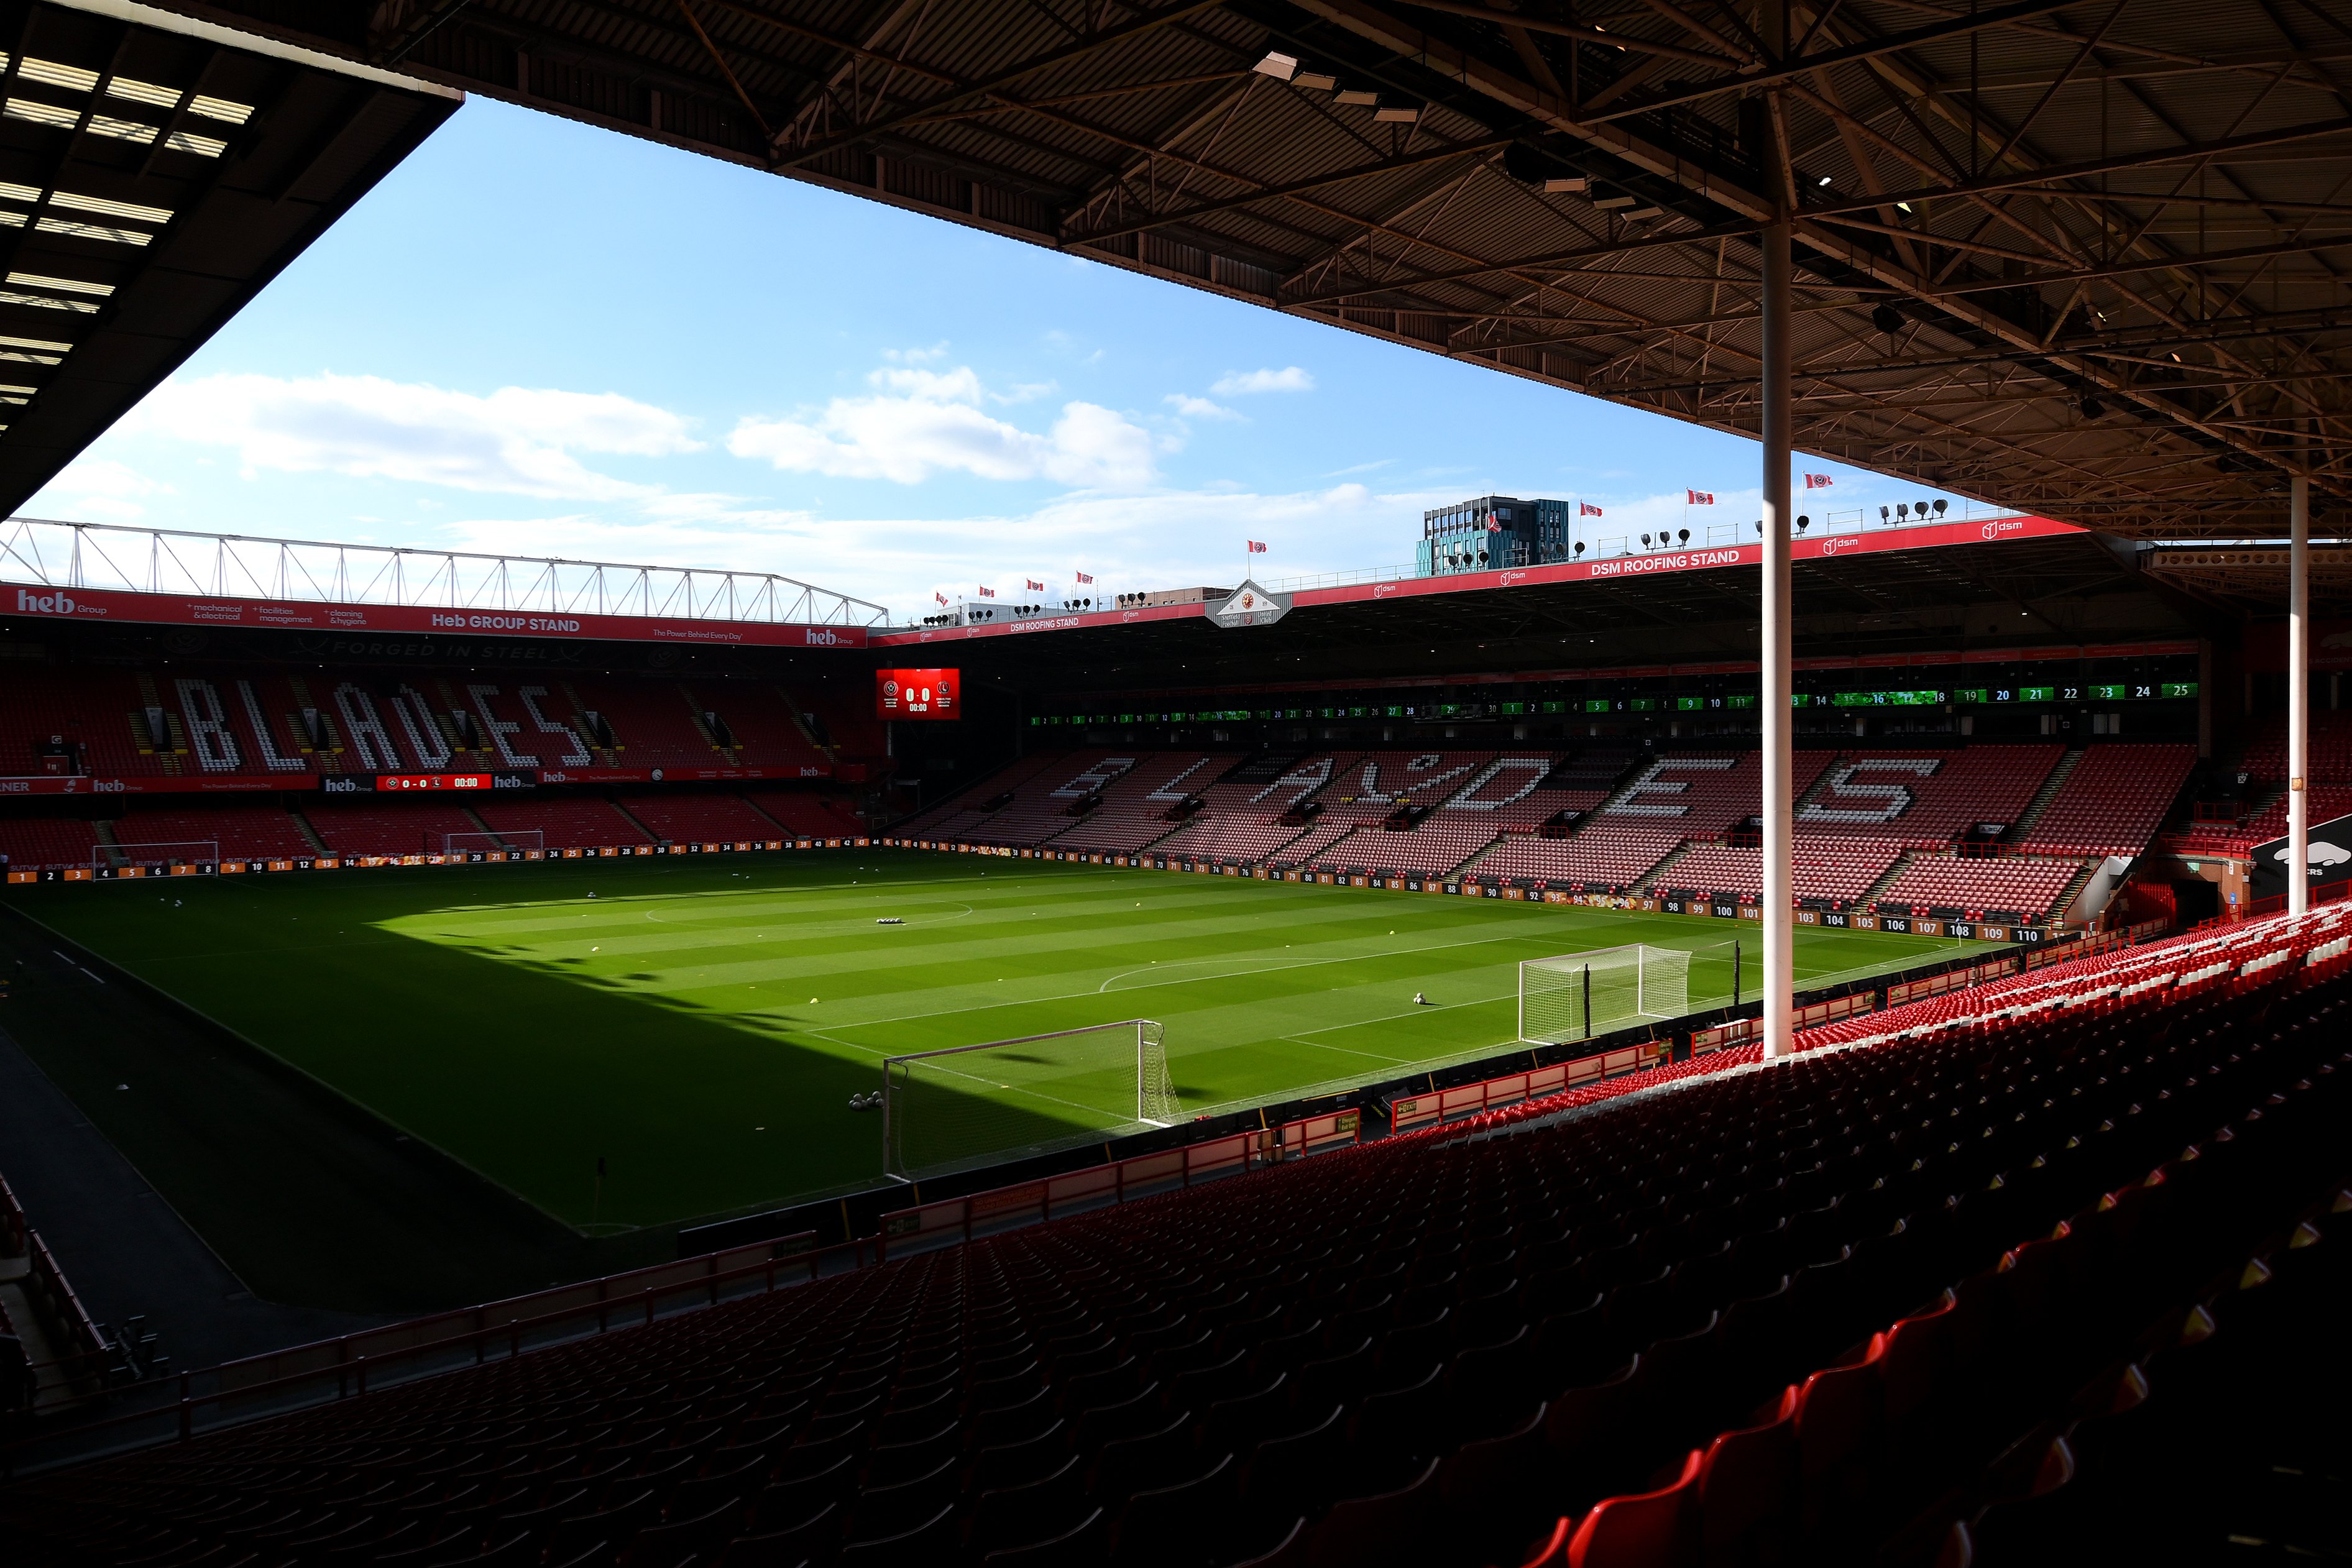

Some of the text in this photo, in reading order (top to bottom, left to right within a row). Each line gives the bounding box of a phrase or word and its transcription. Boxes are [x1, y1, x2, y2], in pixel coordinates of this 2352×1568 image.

[1998, 521, 2023, 531] dsm
[1837, 538, 1858, 548] dsm
[1591, 549, 1740, 576] DSM ROOFING STAND
[1510, 571, 1526, 579] dsm
[1382, 584, 1396, 592] dsm
[17, 589, 108, 615] heb Group
[194, 603, 242, 613] mechanical
[259, 605, 295, 615] facilities
[194, 611, 241, 620] &electrical
[259, 615, 313, 625] management
[330, 609, 364, 620] cleaning
[330, 617, 367, 626] &hygiene
[431, 613, 581, 633] Heb GROUP STAND
[1010, 617, 1079, 632] DSM ROOFING STAND
[653, 629, 666, 637] The
[666, 630, 687, 638] Power
[687, 630, 710, 639] Behind
[710, 631, 728, 641] Every
[806, 628, 837, 645] heb
[332, 641, 436, 658] FORGED
[481, 646, 548, 660] STEEL
[906, 688, 930, 702] 0 0
[1510, 685, 2188, 712] 1 2 3 5 6 7 9 10 11 14 18 19 20 21 22 23 24 25
[909, 704, 927, 712] 00:00
[1389, 707, 1396, 715] 27
[1407, 707, 1414, 715] 28
[543, 771, 566, 782] heb
[800, 766, 819, 776] heb
[93, 779, 126, 792] heb
[325, 777, 357, 792] heb
[402, 779, 427, 788] 0 0
[454, 777, 478, 787] 00:00
[495, 775, 522, 788] heb
[19, 873, 25, 881] 1
[47, 872, 54, 880] 2
[75, 871, 81, 879] 3
[102, 869, 109, 878] 4
[129, 868, 135, 876] 5
[155, 868, 161, 876] 6
[205, 865, 211, 873] 8
[230, 864, 236, 872] 9
[252, 863, 262, 871] 10
[322, 860, 332, 868] 13
[1184, 863, 1190, 871] 72
[1272, 871, 1280, 879] 78
[1338, 876, 1346, 884] 82
[1409, 881, 1418, 891] 86
[1487, 888, 1497, 897] 90
[1643, 900, 1654, 909] 97
[1668, 902, 1679, 912] 98
[1693, 904, 1704, 914] 99
[1716, 906, 1732, 916] 100
[1743, 908, 1758, 919] 101
[1798, 912, 1814, 923] 103
[1826, 915, 1844, 925] 104
[1856, 917, 1873, 928] 105
[1886, 920, 1905, 931] 106
[1918, 922, 1937, 933] 107
[1950, 925, 1969, 937] 108
[1983, 928, 2003, 939] 109
[2017, 930, 2037, 942] 110
